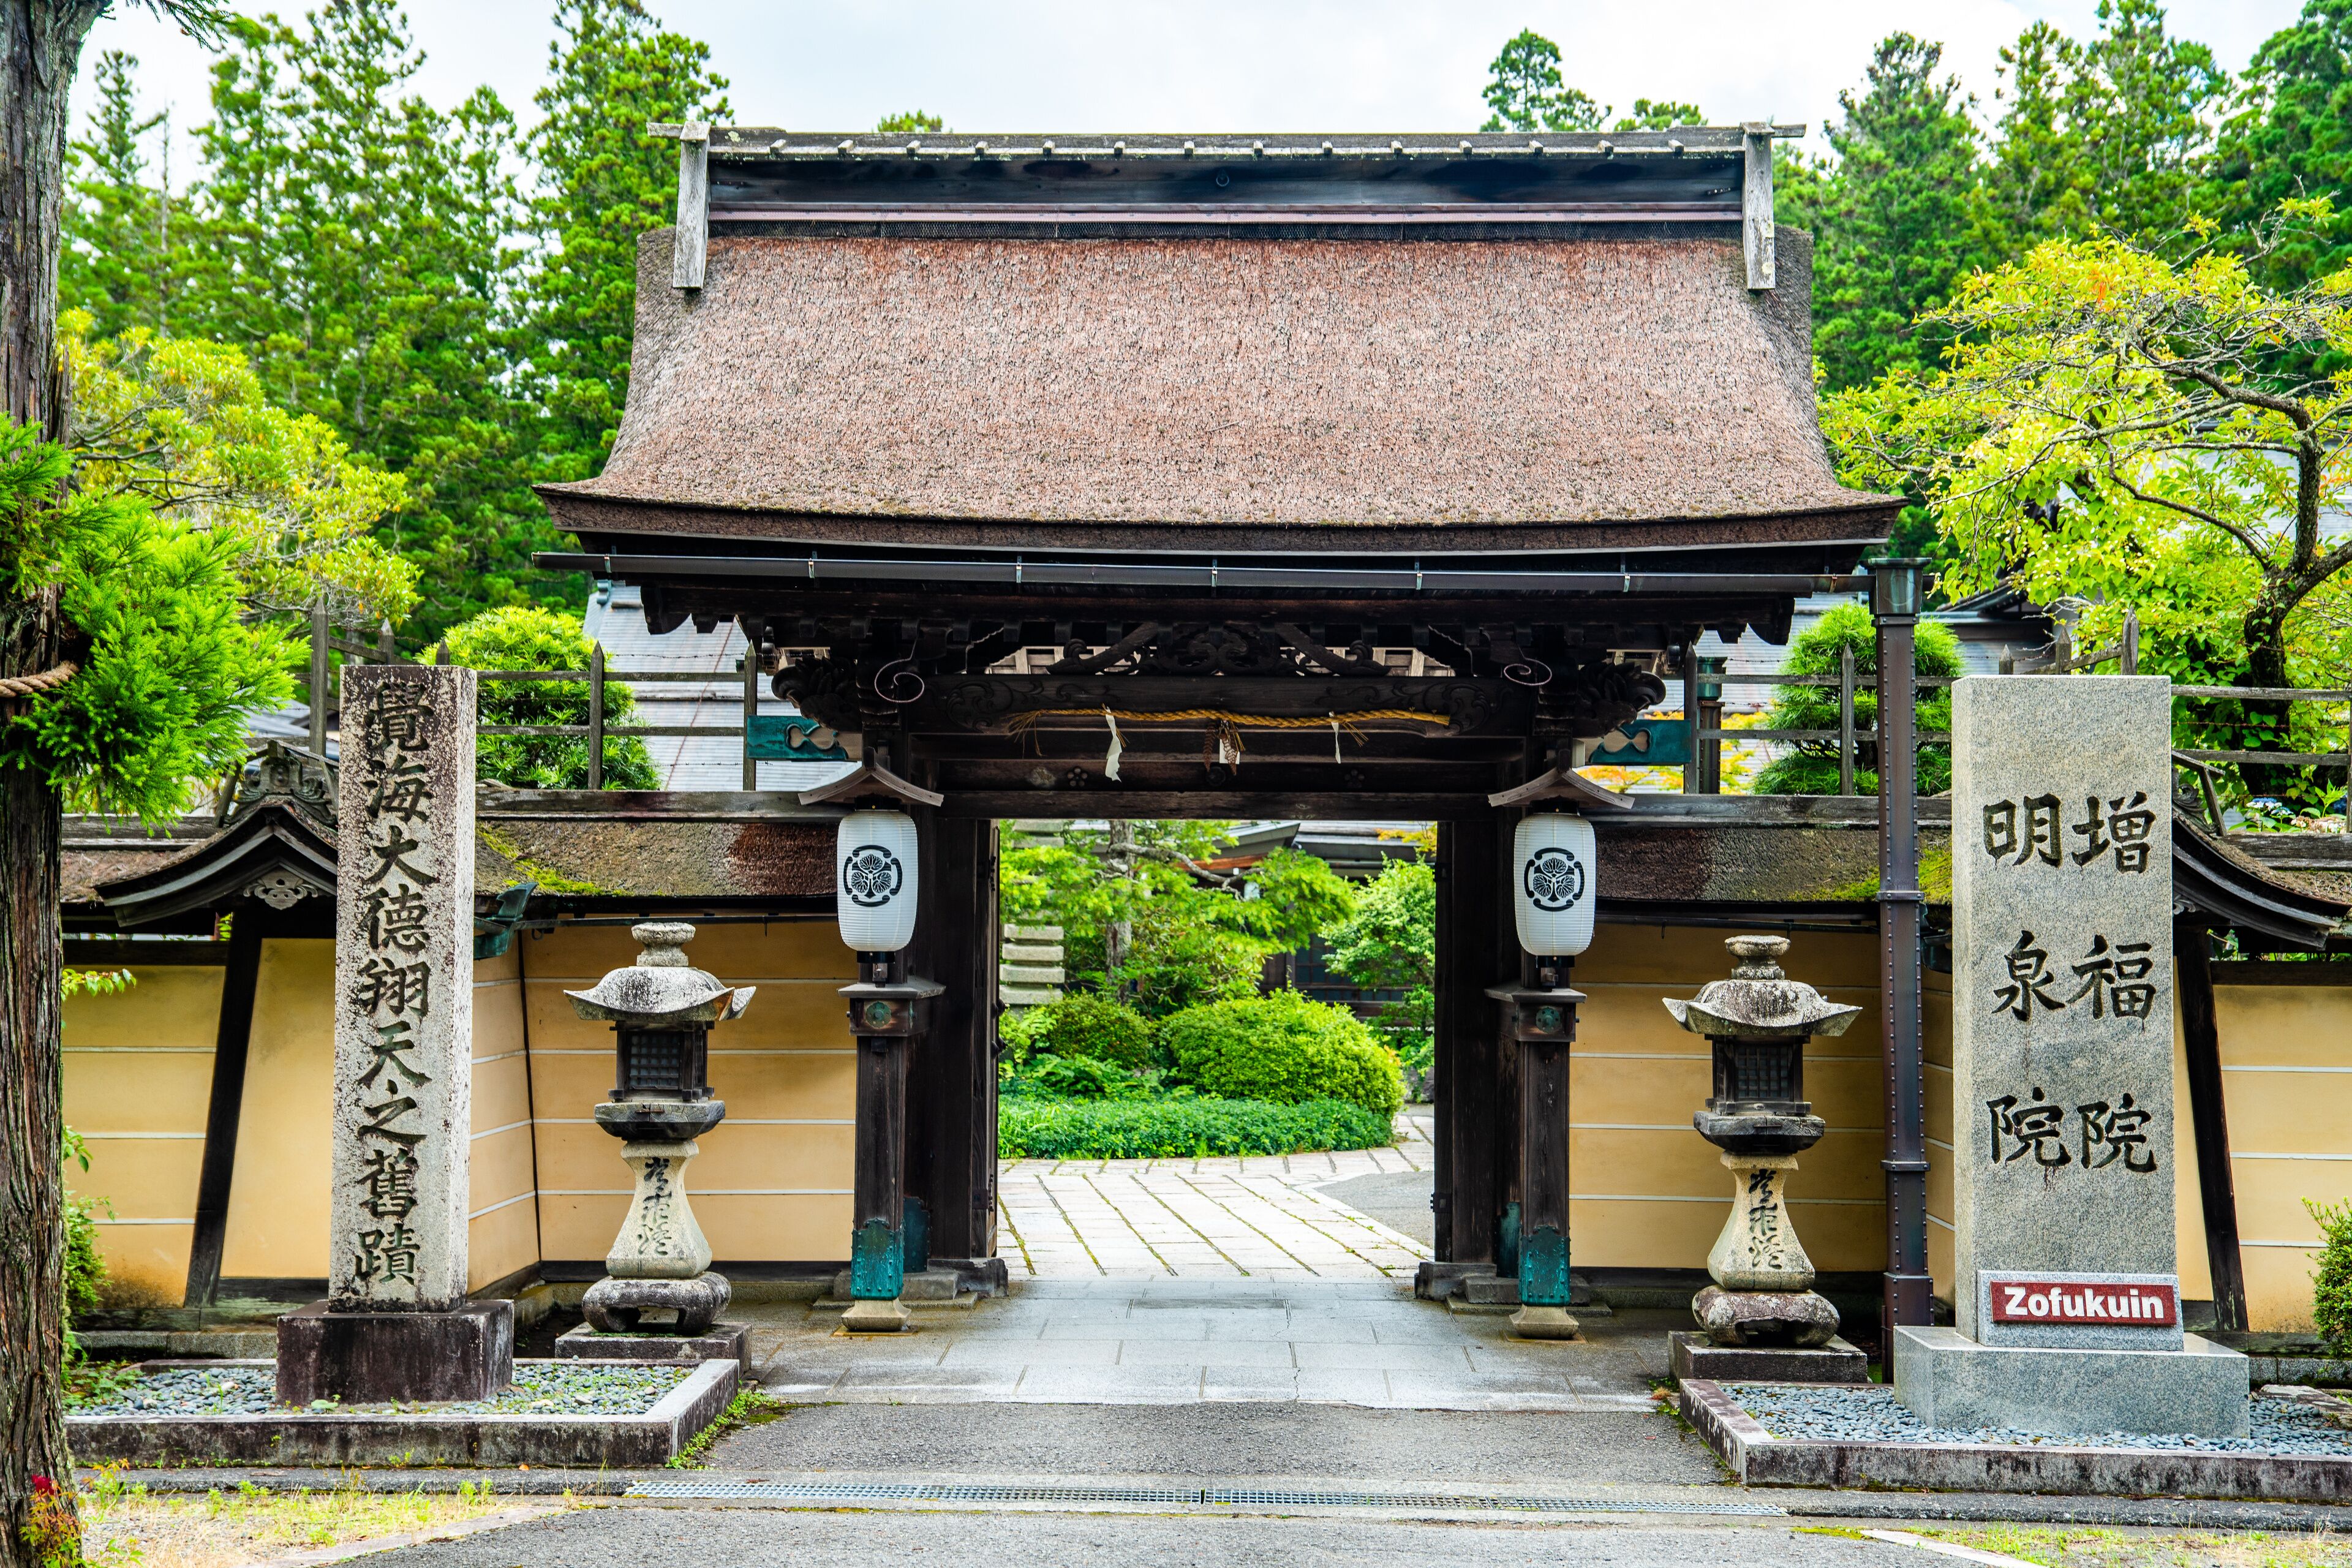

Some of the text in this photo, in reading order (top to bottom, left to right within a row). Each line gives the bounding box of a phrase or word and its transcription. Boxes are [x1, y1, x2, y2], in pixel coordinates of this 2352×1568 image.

[1983, 793, 2071, 1169] 明泉院
[2066, 791, 2158, 1174] 増福院
[2004, 1286, 2164, 1319] Zofukuin
